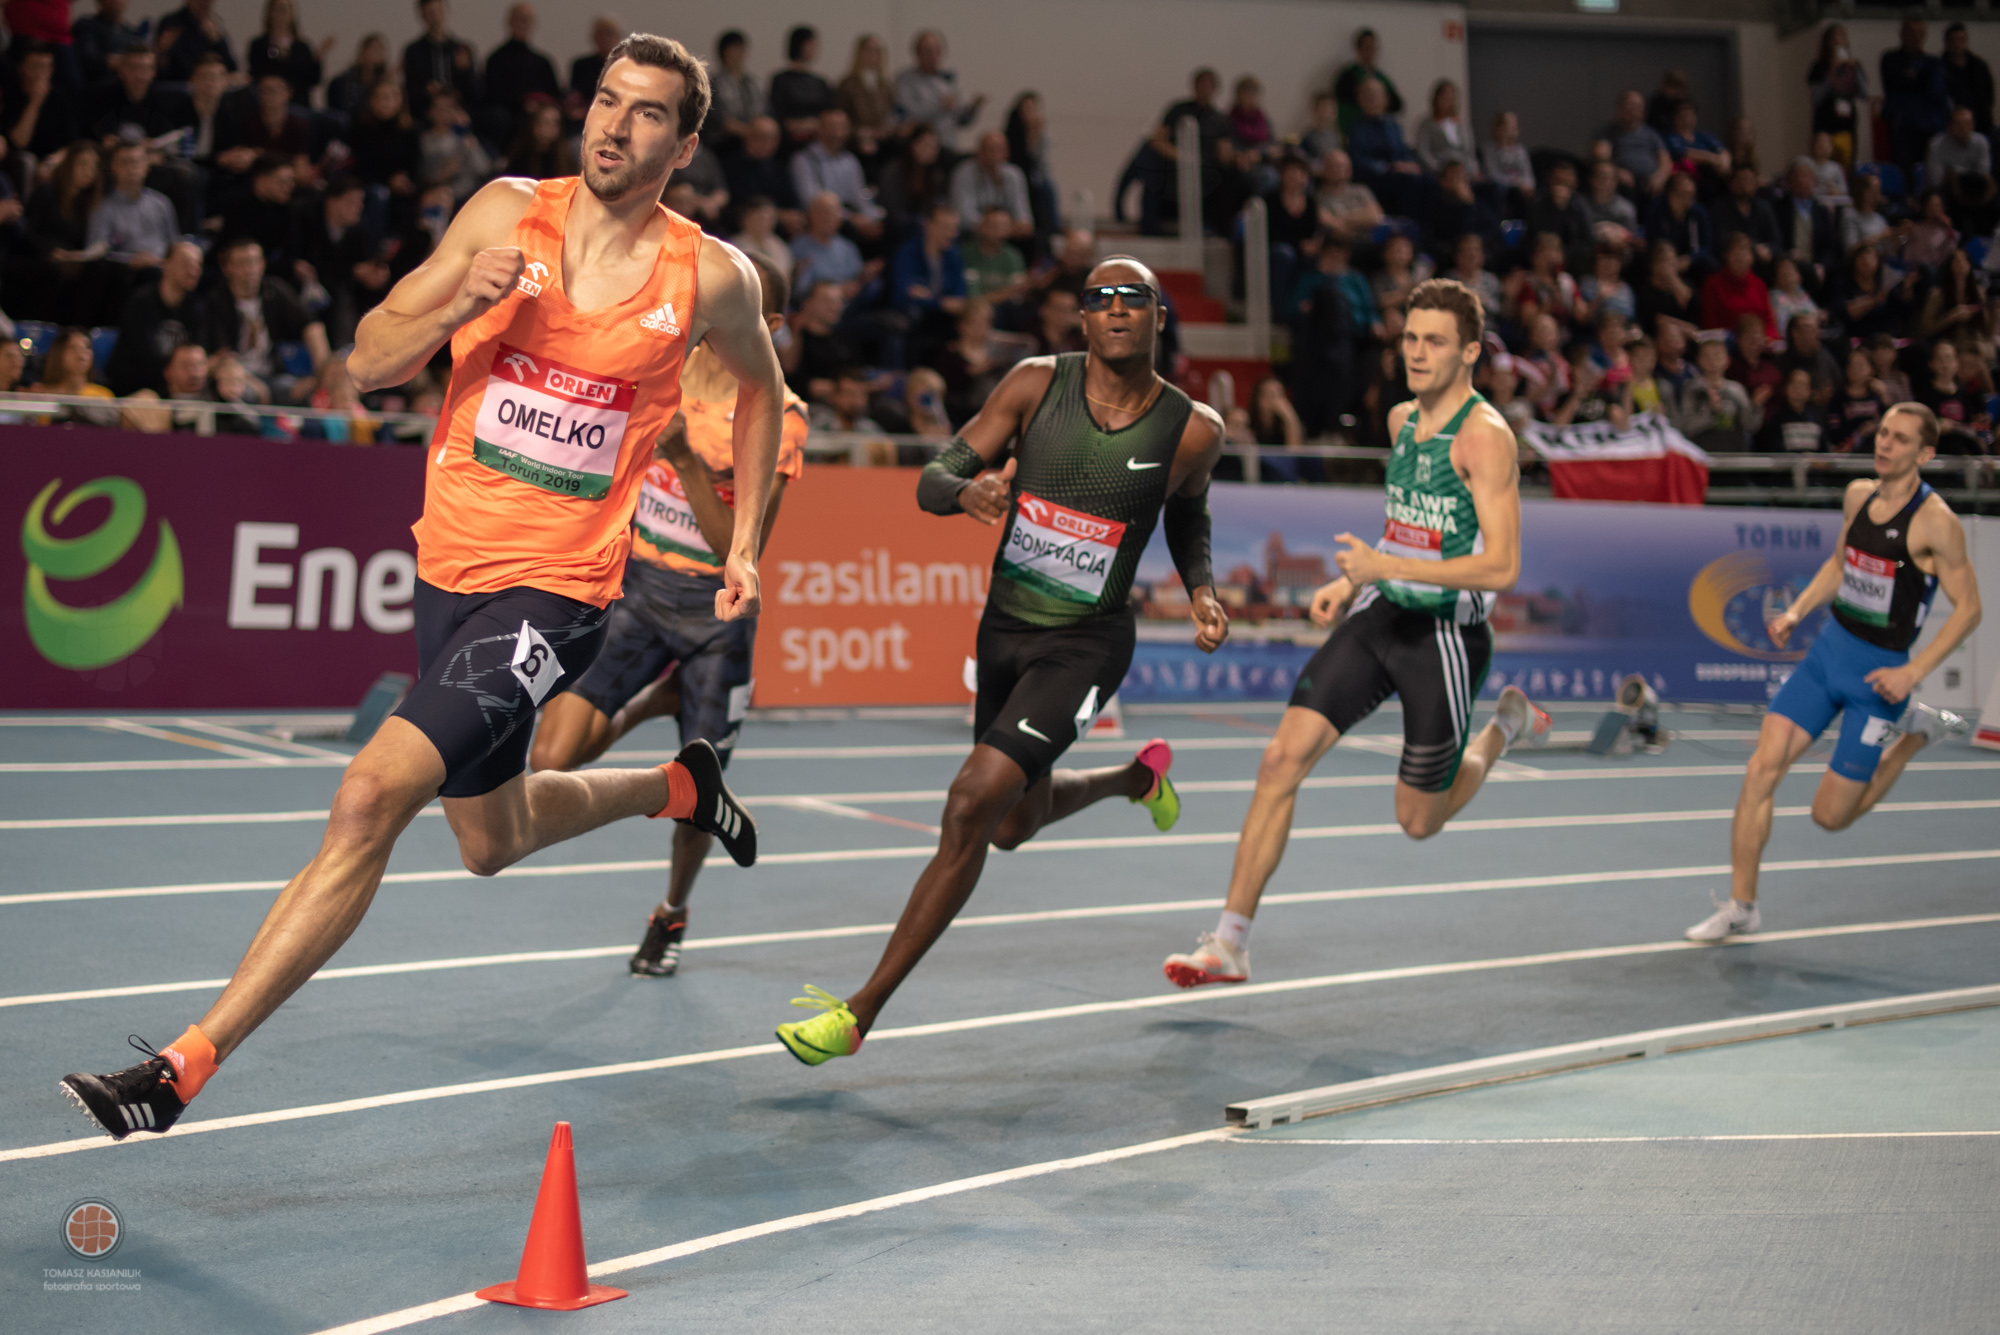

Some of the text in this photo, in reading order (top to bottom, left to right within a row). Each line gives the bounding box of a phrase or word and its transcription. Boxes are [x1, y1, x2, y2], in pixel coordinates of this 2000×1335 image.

[640, 317, 681, 337] adidas
[549, 373, 613, 401] ORLEN
[497, 398, 606, 450] OMELKO
[498, 449, 585, 480] IAAF World Indoor Tour
[501, 457, 581, 492] Toruń 2019
[1410, 490, 1458, 514] AWF
[227, 521, 417, 634] Ene
[780, 621, 912, 687] sport
